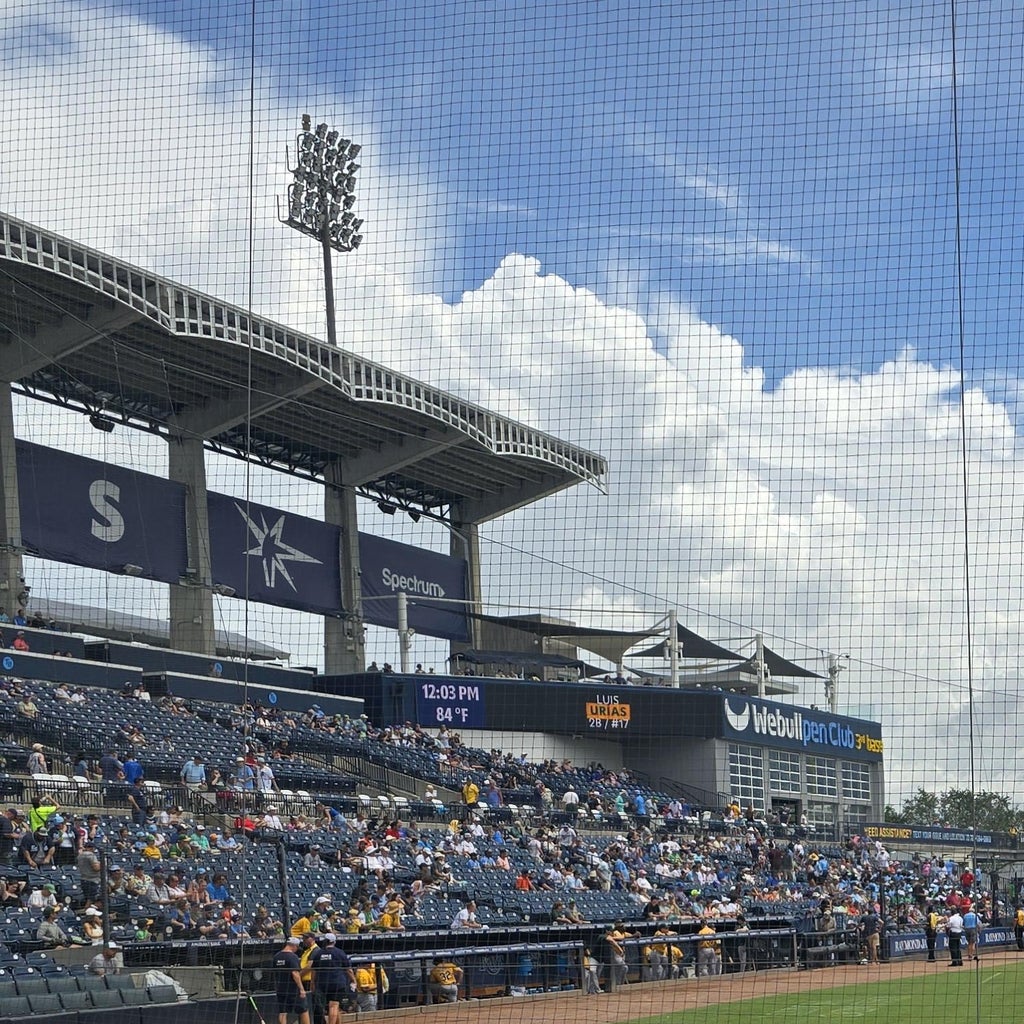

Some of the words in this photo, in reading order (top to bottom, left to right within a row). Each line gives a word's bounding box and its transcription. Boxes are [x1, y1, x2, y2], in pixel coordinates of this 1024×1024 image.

[382, 568, 441, 597] Spectrum
[422, 683, 456, 700] 12:03
[459, 685, 480, 701] PM
[596, 694, 619, 704] LUIS
[436, 706, 452, 722] 84
[590, 705, 627, 717] URIAS
[589, 718, 602, 728] 2B
[611, 718, 629, 729] #17
[829, 722, 855, 749] Club
[439, 970, 452, 981] 32
